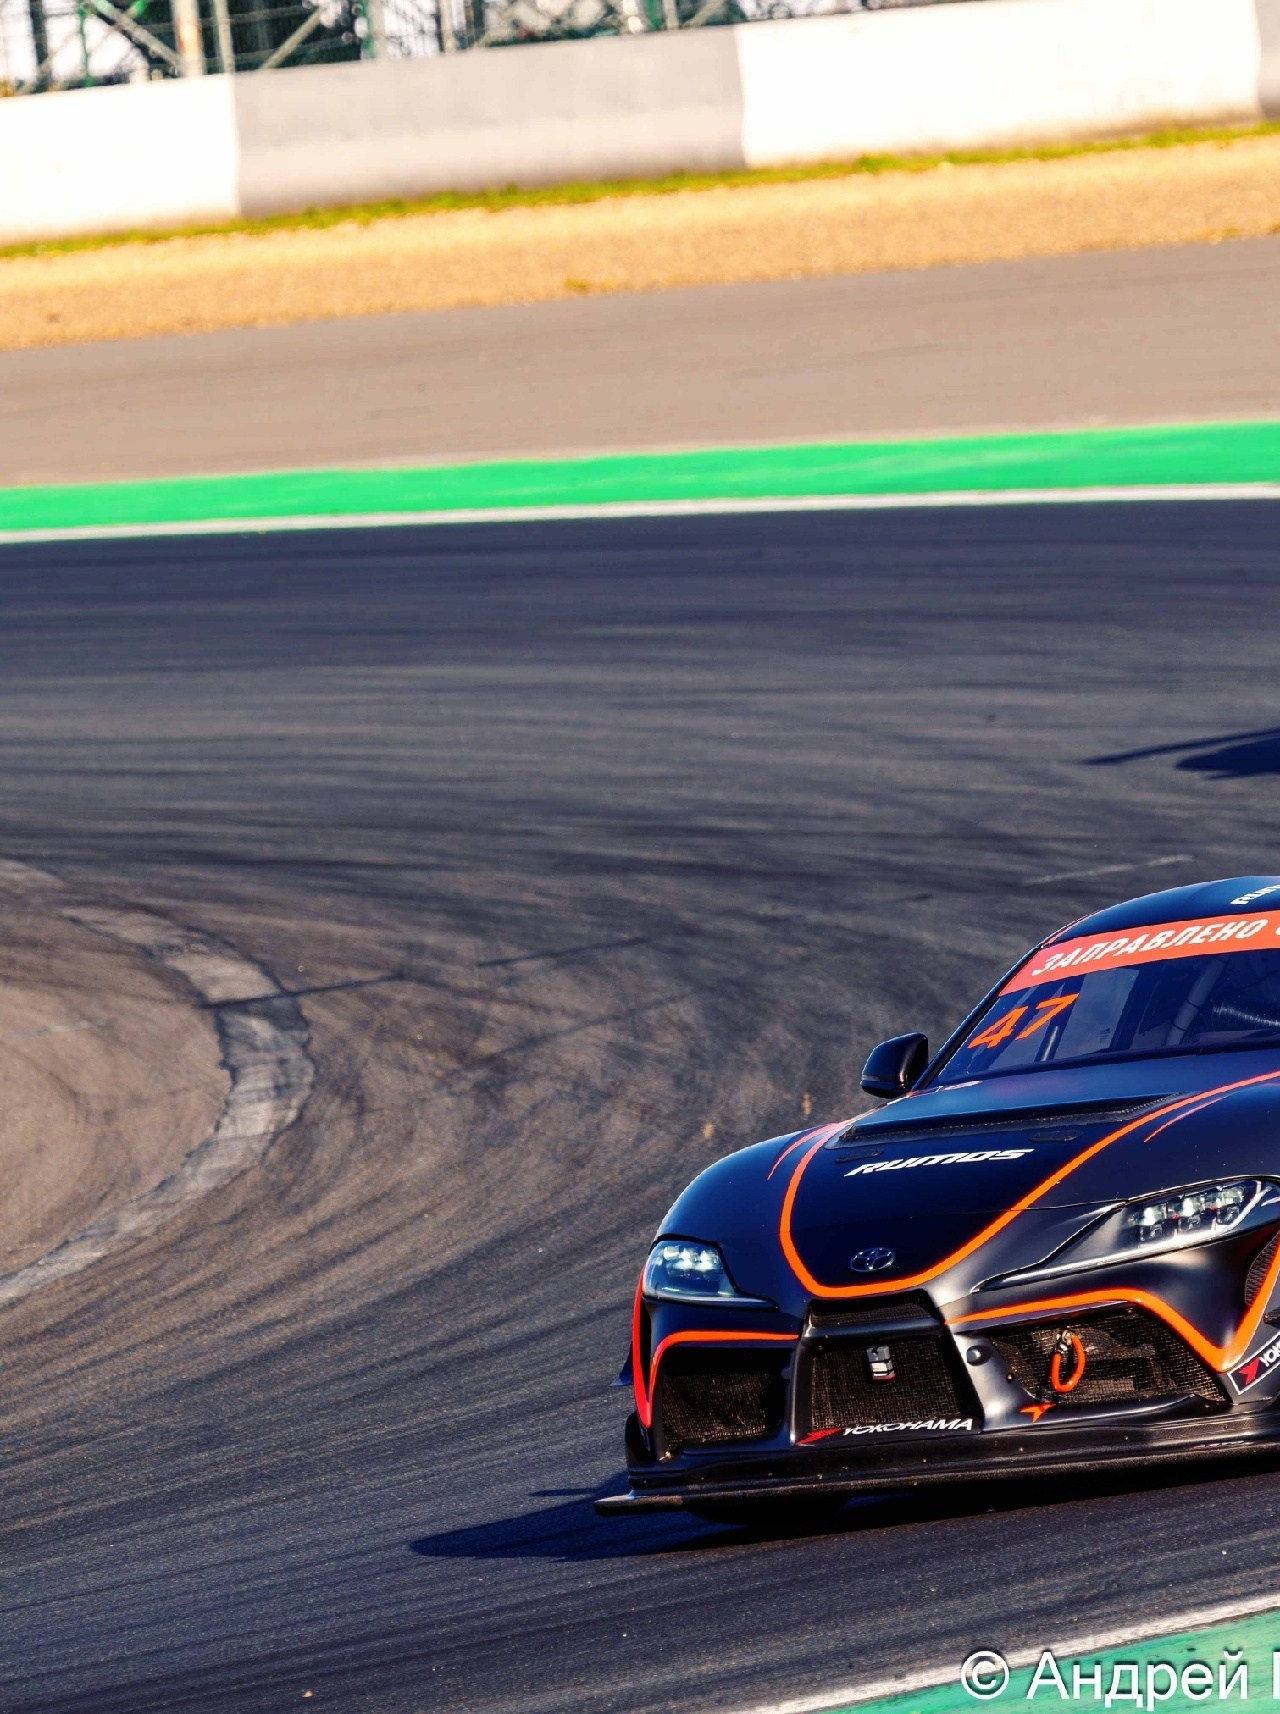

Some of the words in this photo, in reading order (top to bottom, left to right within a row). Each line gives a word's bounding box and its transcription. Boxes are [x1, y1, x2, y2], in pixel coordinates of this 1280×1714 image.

[1031, 918, 1269, 977] ЗАПРАВЛЕНО
[967, 992, 1080, 1049] 47
[843, 1148, 1035, 1177] RUMOS
[842, 1418, 974, 1436] YOKOHAMA
